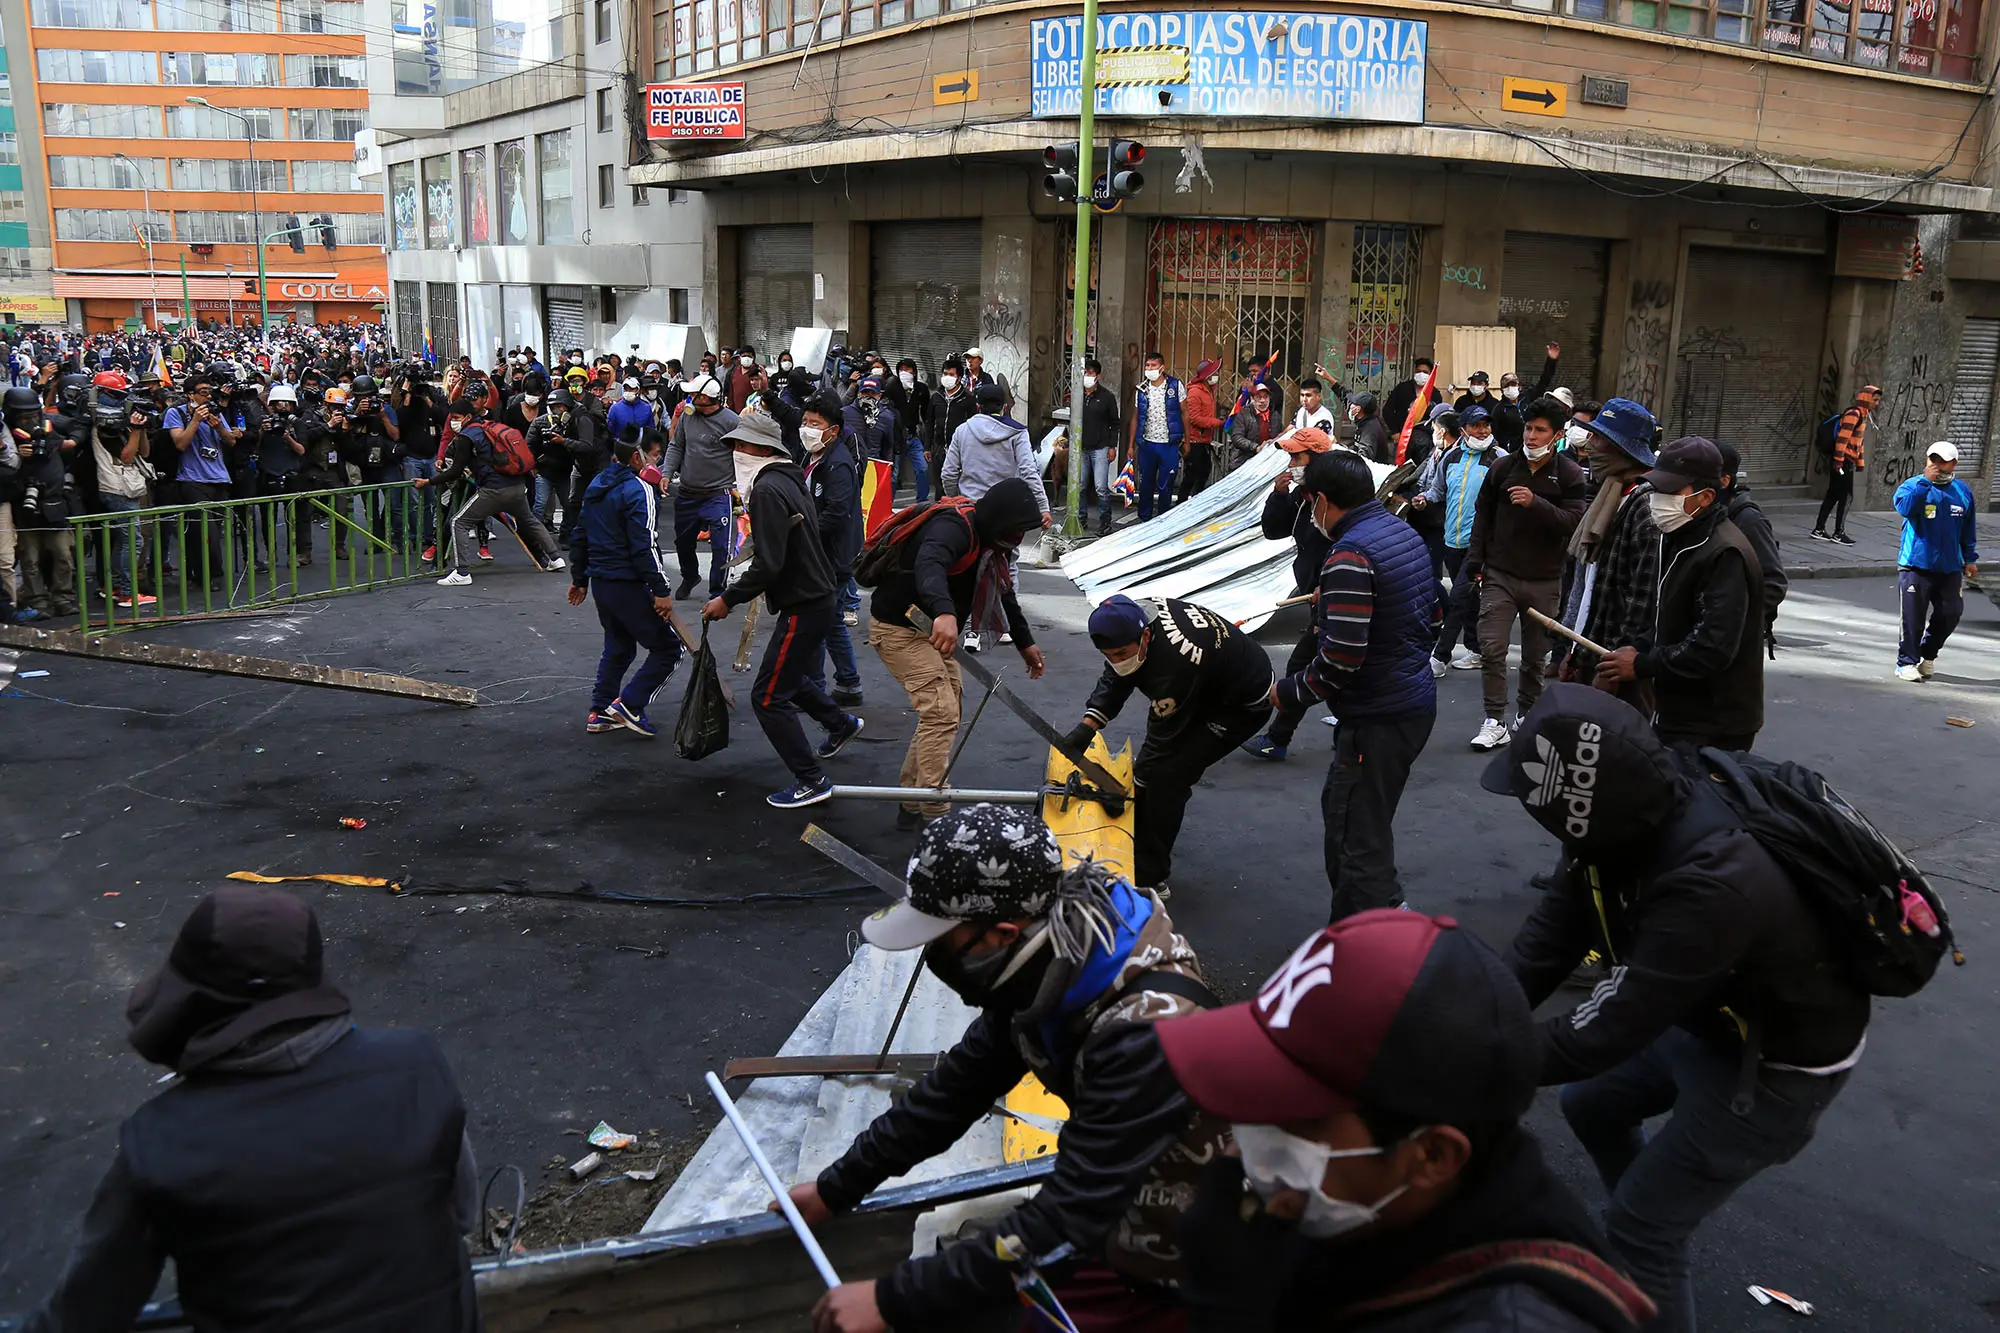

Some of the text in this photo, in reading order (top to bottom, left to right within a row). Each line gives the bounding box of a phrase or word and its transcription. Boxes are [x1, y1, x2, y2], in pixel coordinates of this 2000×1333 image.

[1032, 14, 1423, 62] FOTOCOPIAS VICTORIA
[1102, 55, 1171, 68] PUBLICIDAD
[1033, 59, 1083, 88] LIBRE
[1257, 58, 1287, 86] DE
[1292, 58, 1423, 92] ESCRITORIO
[1110, 66, 1183, 78] AUTORIZADA
[652, 88, 743, 104] NOTARIA DE
[1033, 88, 1083, 115] SELLOS
[1189, 86, 1315, 114] FOTOCOPIAS
[1321, 89, 1345, 115] DE
[1351, 91, 1420, 120] PLANOS
[652, 109, 739, 124] FE PUBLICA
[1187, 270, 1280, 278] LIBERA VCTORIA
[281, 283, 361, 299] COTEL
[200, 301, 242, 309] INTERNET
[1911, 354, 1928, 380] NI
[1904, 431, 1917, 450] NI
[1883, 454, 1916, 485] EVO
[1563, 722, 1602, 838] adidas
[978, 878, 1011, 887] adidas
[1257, 927, 1335, 1029] NY
